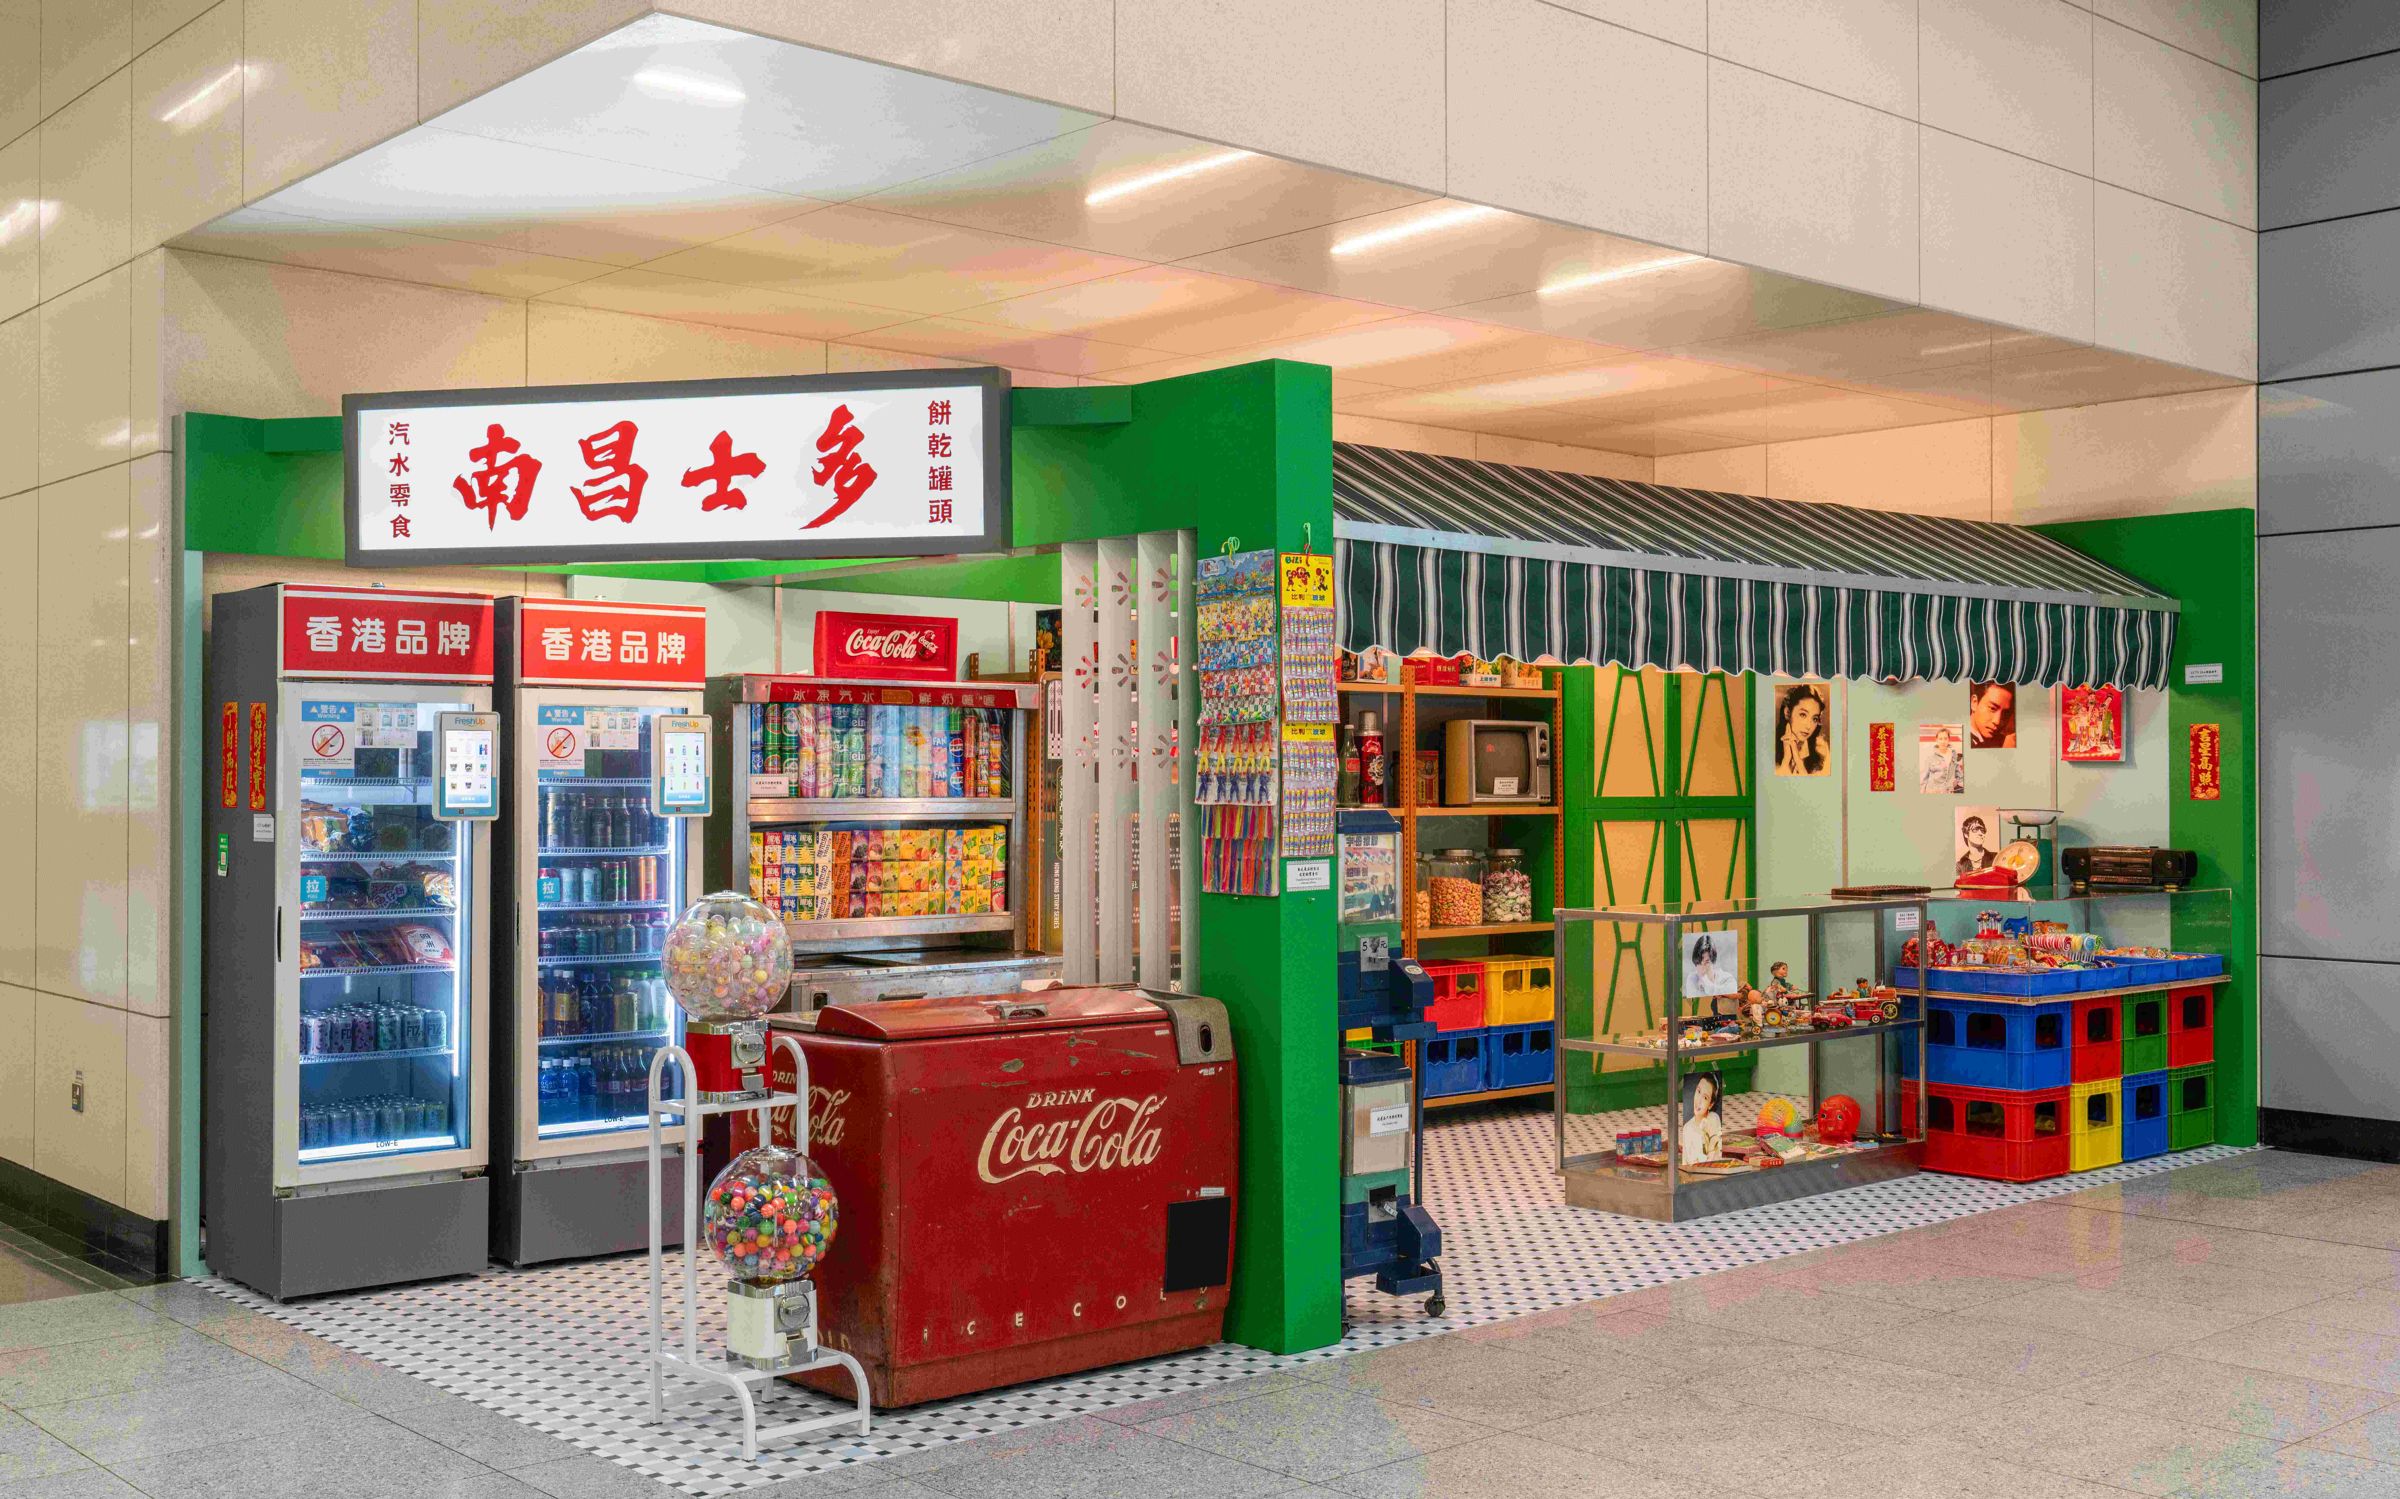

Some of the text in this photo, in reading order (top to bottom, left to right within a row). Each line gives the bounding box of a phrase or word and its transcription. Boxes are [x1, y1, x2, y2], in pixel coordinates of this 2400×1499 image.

[452, 403, 878, 532] 南昌士多
[928, 399, 953, 524] 餅乾罐頭
[388, 421, 412, 539] 汽水零食
[306, 616, 471, 657] 香港品牌
[541, 627, 686, 665] 香港品牌
[845, 627, 921, 659] Coca-Cola
[792, 688, 874, 703] 冰凍汽水
[454, 716, 486, 726] FreshUp
[671, 720, 699, 728] FreshUp
[1875, 726, 1890, 780] 恭喜發財
[2197, 727, 2214, 787] 吉星高照
[305, 879, 320, 894] 拉
[542, 881, 555, 895] 拉
[1362, 941, 1368, 952] 5
[772, 1070, 797, 1085] DRIN
[1026, 1087, 1097, 1110] DRINK
[375, 1139, 399, 1149] LOW-E
[977, 1093, 1168, 1185] Coca-Cola
